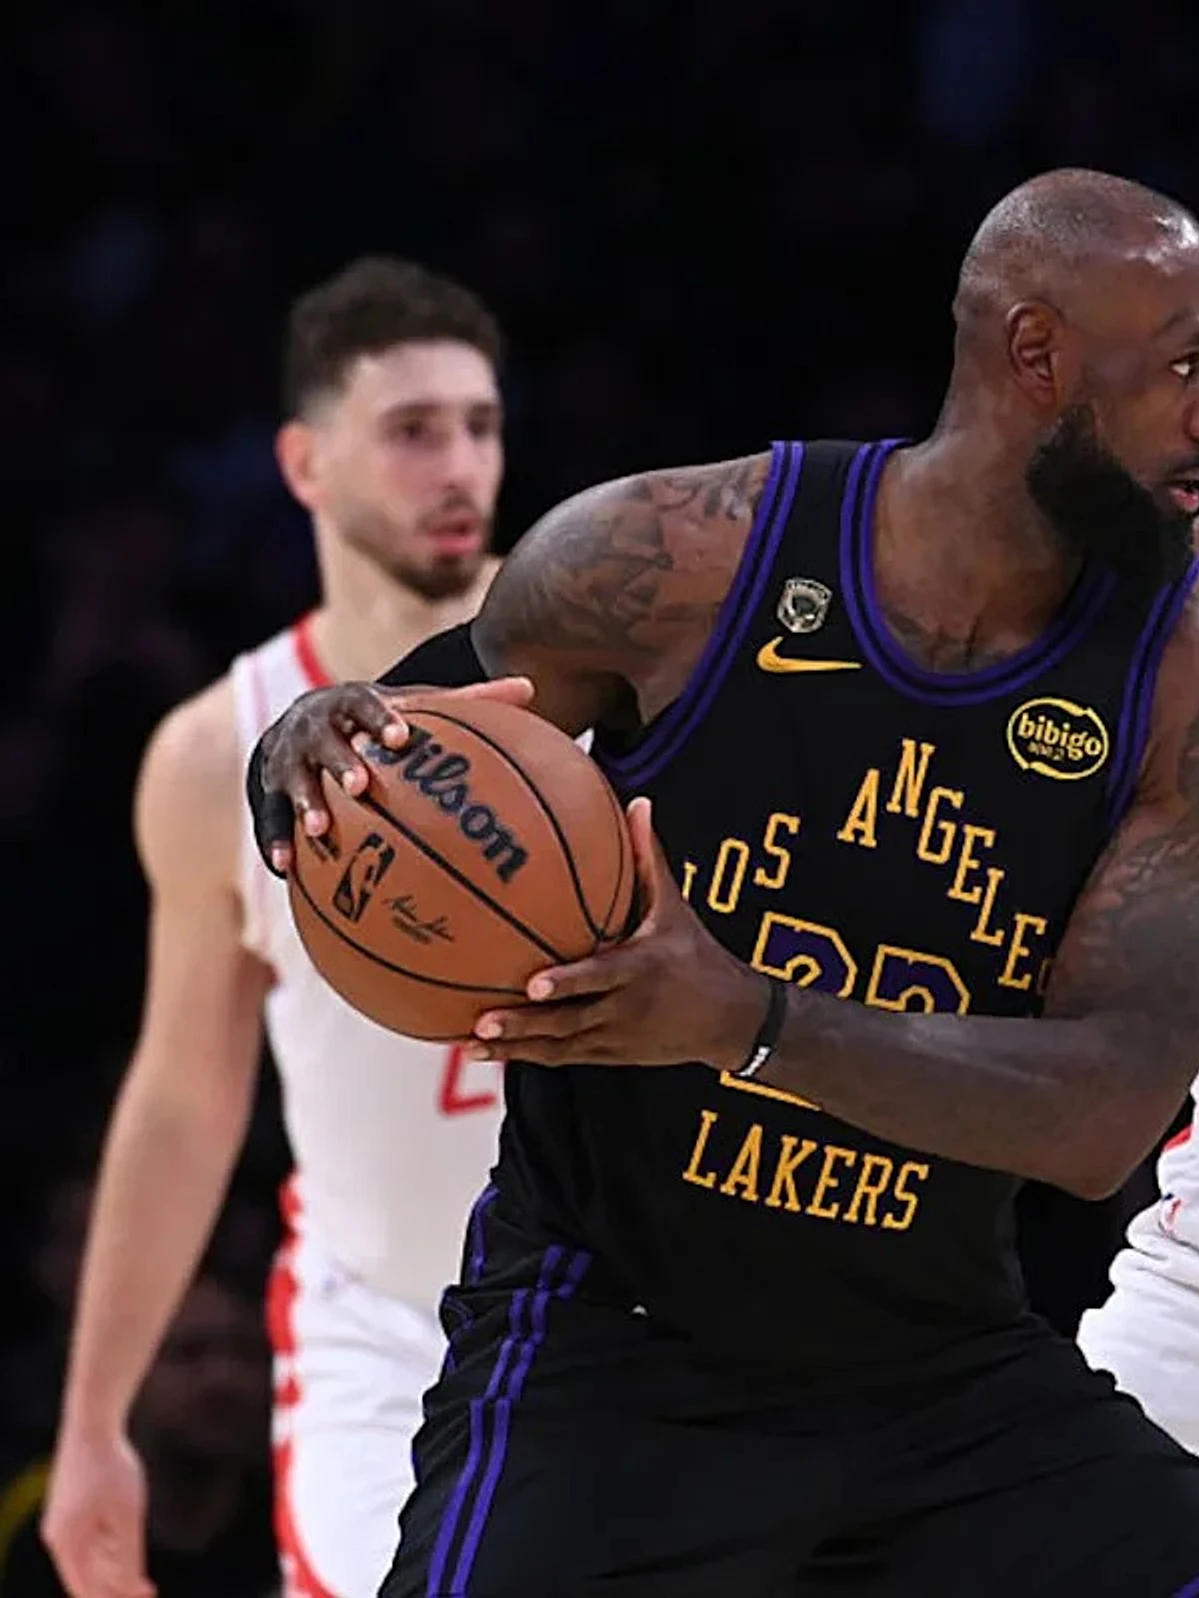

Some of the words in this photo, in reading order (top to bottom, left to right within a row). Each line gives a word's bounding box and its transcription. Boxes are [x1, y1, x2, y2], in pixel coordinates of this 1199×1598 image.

[1017, 712, 1102, 761] bibigo
[837, 738, 1051, 994] ANGELE
[682, 1109, 930, 1231] LAKERS
